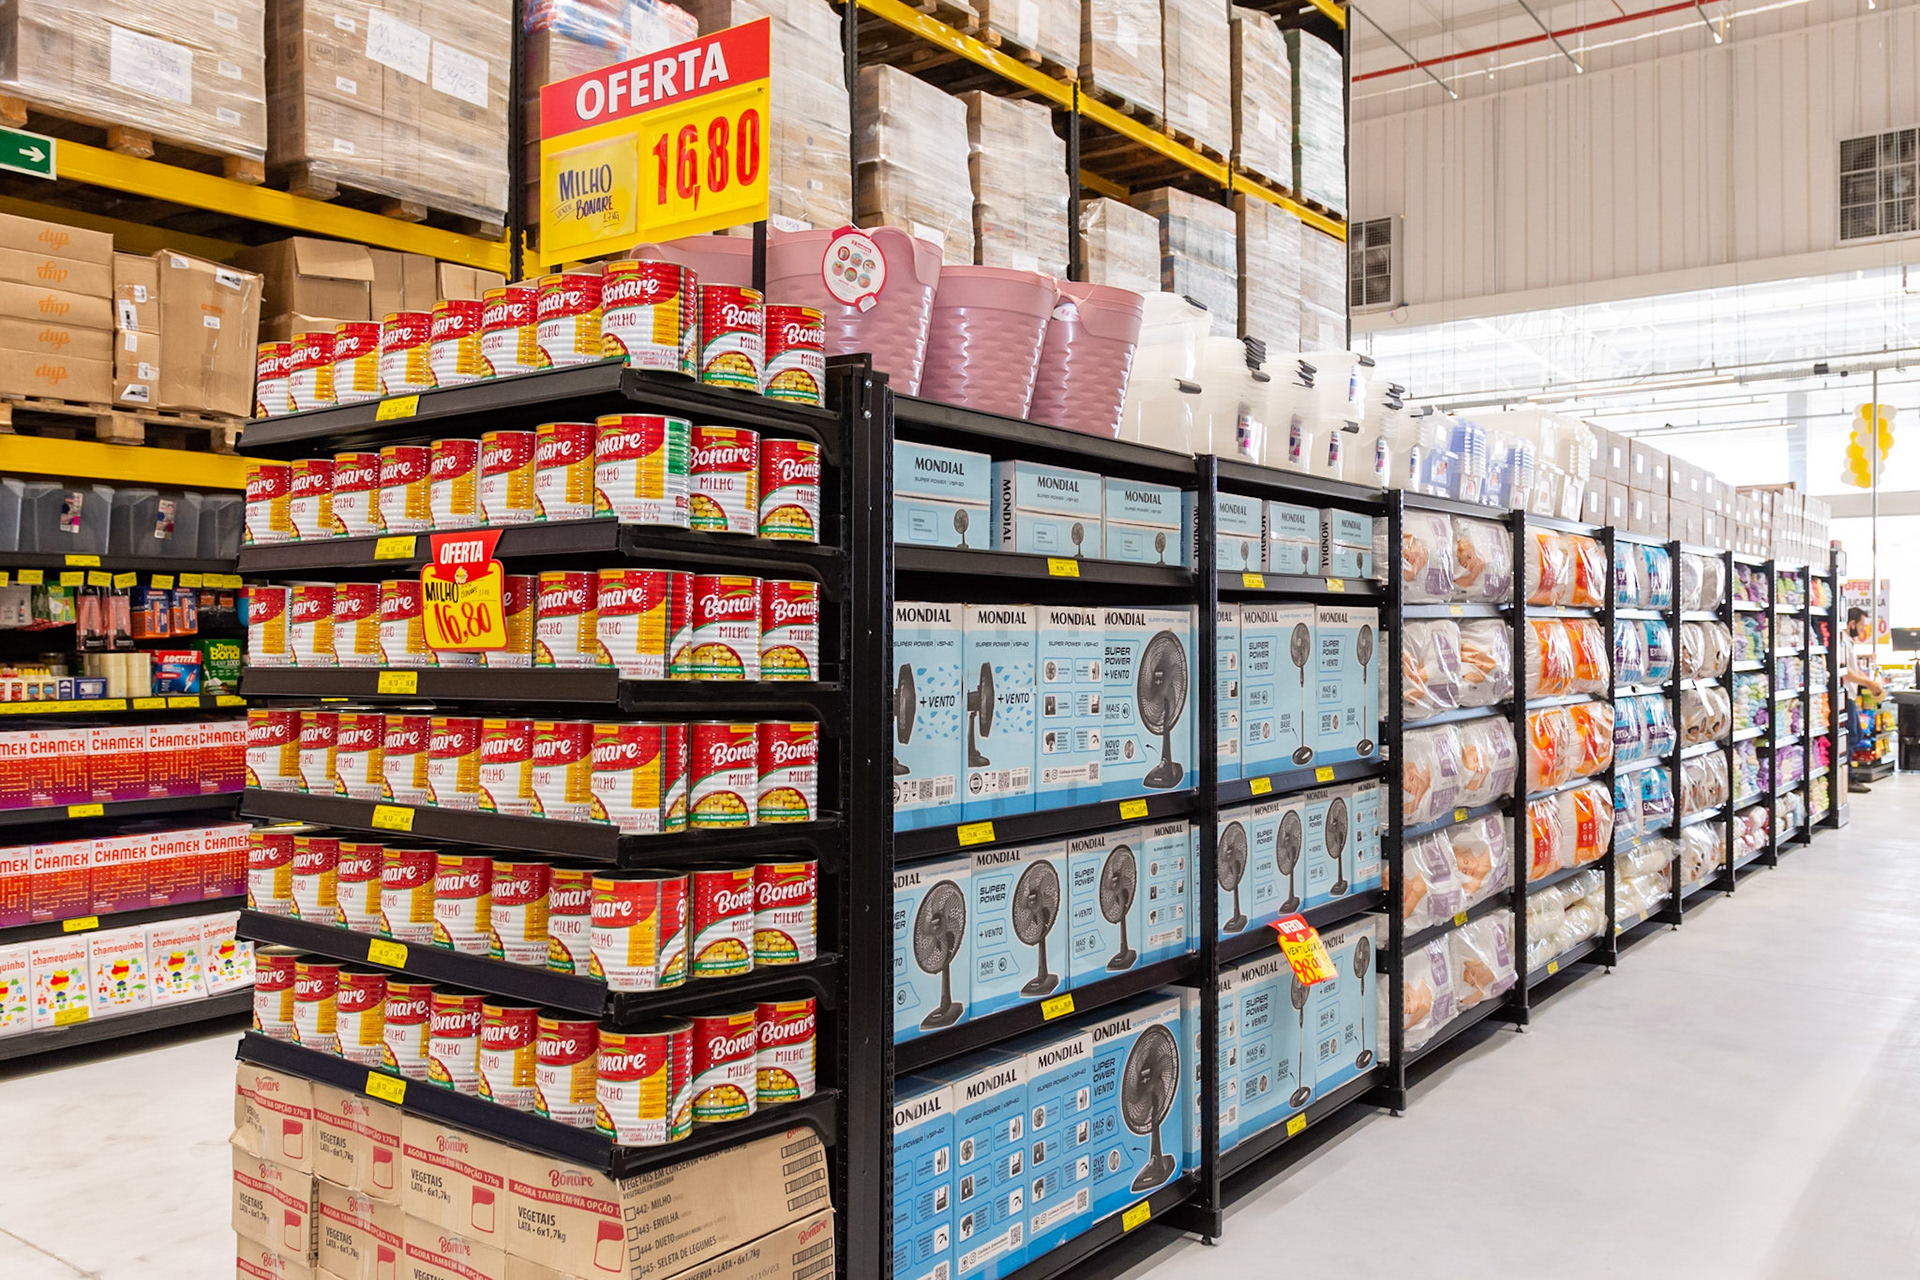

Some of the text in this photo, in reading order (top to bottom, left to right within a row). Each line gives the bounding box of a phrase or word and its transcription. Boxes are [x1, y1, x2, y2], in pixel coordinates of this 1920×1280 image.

[576, 41, 729, 120] OFERTA
[652, 108, 760, 212] 16,80
[559, 163, 612, 202] MILHO
[576, 195, 614, 220] BONARE
[607, 312, 637, 328] MILHO
[690, 444, 751, 469] Bonare
[915, 457, 965, 476] MONDIAL
[700, 477, 734, 491] MILHO
[1037, 476, 1080, 492] MONDIAL
[1125, 490, 1162, 505] MONDIAL
[1002, 479, 1012, 543] MONDIAL
[1219, 503, 1247, 516] MONDIAL
[1281, 512, 1305, 524] MONDIAL
[1341, 519, 1361, 531] MONDIAL
[440, 540, 484, 565] OFERTA
[1321, 521, 1329, 568] MONDIAL
[425, 582, 459, 603] MILHO
[435, 602, 492, 644] 16,80
[896, 608, 951, 624] MONDIAL
[977, 610, 1027, 624] MONDIAL
[1050, 611, 1096, 626] MONDIAL
[1244, 611, 1278, 623] MONDIAL
[1320, 612, 1348, 623] MONDIAL
[719, 626, 750, 640] MILHO
[1104, 648, 1131, 656] SUPER
[1249, 641, 1269, 650] SUPER
[163, 655, 198, 664] LOCTITE
[210, 648, 240, 660] Bond
[1104, 657, 1131, 665] POWER
[1249, 650, 1269, 659] POWER
[92, 736, 144, 751] CHAMEX
[150, 734, 198, 748] CHAMEX
[200, 731, 247, 744] CHAMEX
[31, 740, 85, 754] CHAMEX
[1306, 790, 1329, 801] MONDIAL
[1254, 803, 1280, 816] MONDIAL
[1154, 824, 1183, 836] MONDIAL
[151, 839, 200, 856] CHAMEX
[1070, 836, 1106, 853] MONDIAL
[34, 853, 89, 870] CHAMEX
[95, 846, 147, 862] CHAMEX
[976, 850, 1020, 866] MONDIAL
[1074, 868, 1095, 878] SUPER
[1074, 875, 1095, 887] POWER
[756, 879, 815, 906] Bonare
[979, 883, 1006, 895] SUPER
[549, 886, 592, 910] Bonar
[979, 893, 1006, 905] POWER
[437, 903, 461, 916] MILHO
[773, 910, 804, 924] MILHO
[553, 920, 582, 935] MILHO
[92, 941, 144, 956] chamequinho
[152, 933, 200, 948] chamequinho
[32, 950, 85, 967] chamequinho
[1241, 961, 1279, 984] MONDIAL
[1245, 994, 1269, 1009] SUPER
[1245, 1003, 1269, 1017] POWER
[430, 1010, 482, 1032] Bonare
[759, 1013, 815, 1043] Bonare
[1094, 1018, 1131, 1042] ONDIAL
[434, 1041, 461, 1055] MILHO
[775, 1049, 805, 1062] MILHO
[1038, 1041, 1084, 1069] MONDIAL
[966, 1068, 1017, 1101] MONDIAL
[319, 1130, 347, 1148] VEGETAIS
[436, 1135, 469, 1154] Bonare
[407, 1147, 427, 1162] AGORA
[463, 1165, 483, 1180] OPÇÃO
[411, 1168, 443, 1188] VEGETAIS
[548, 1169, 595, 1188] Bonare
[411, 1181, 451, 1203] LATA 6x1,7kg
[514, 1183, 537, 1199] AGORA
[587, 1199, 614, 1215] OPÇÃO
[239, 1192, 263, 1210] VEGETAIS
[651, 1195, 672, 1210] MILHO
[518, 1205, 556, 1226] VEGETAIS
[653, 1211, 679, 1229] ERVILHA
[325, 1226, 353, 1245] VEGETAIS
[518, 1219, 567, 1244] LATA 6x1,7kg
[655, 1234, 675, 1248] DUETO
[658, 1253, 680, 1271] SELETA
[680, 1250, 689, 1261] DE
[689, 1235, 717, 1256] LEGUMES
[717, 1260, 733, 1273] LATA
